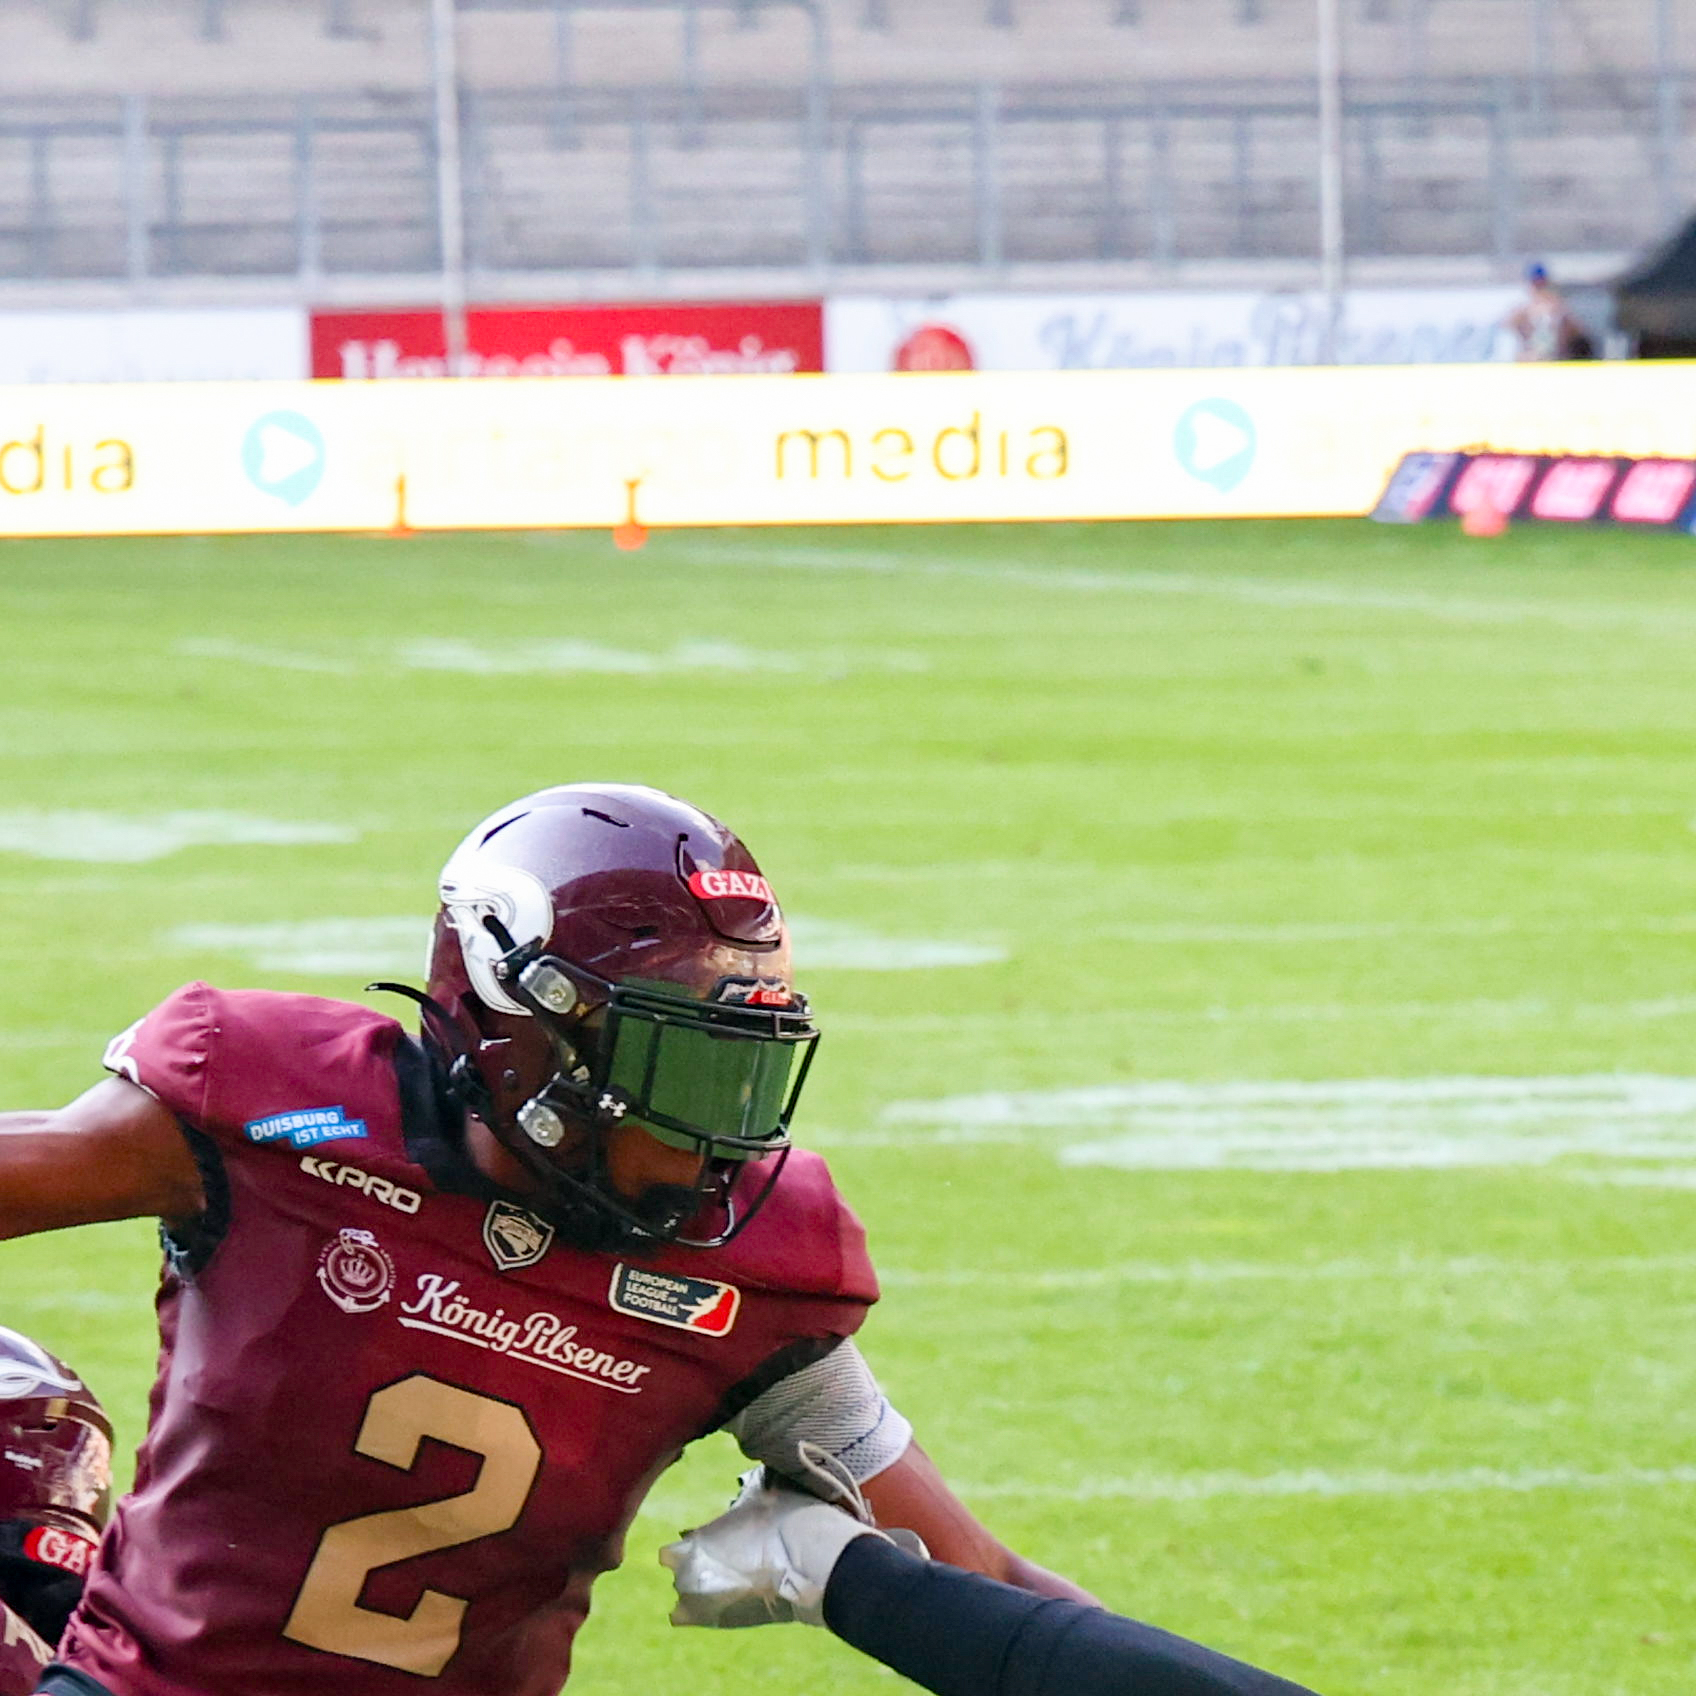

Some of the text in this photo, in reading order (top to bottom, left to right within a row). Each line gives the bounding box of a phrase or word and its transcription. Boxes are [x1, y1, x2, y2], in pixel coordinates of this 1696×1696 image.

[776, 410, 1070, 481] media
[701, 871, 774, 902] GAZI
[250, 1111, 339, 1140] DUISBURG
[294, 1124, 360, 1144] IST ECHT
[625, 1281, 669, 1301] LEAGUE
[628, 1270, 688, 1293] EUROPEAN
[623, 1293, 678, 1316] FOOTBALL
[400, 1273, 651, 1384] König Pilsener
[280, 1370, 545, 1678] 2
[37, 1528, 90, 1576] GA
